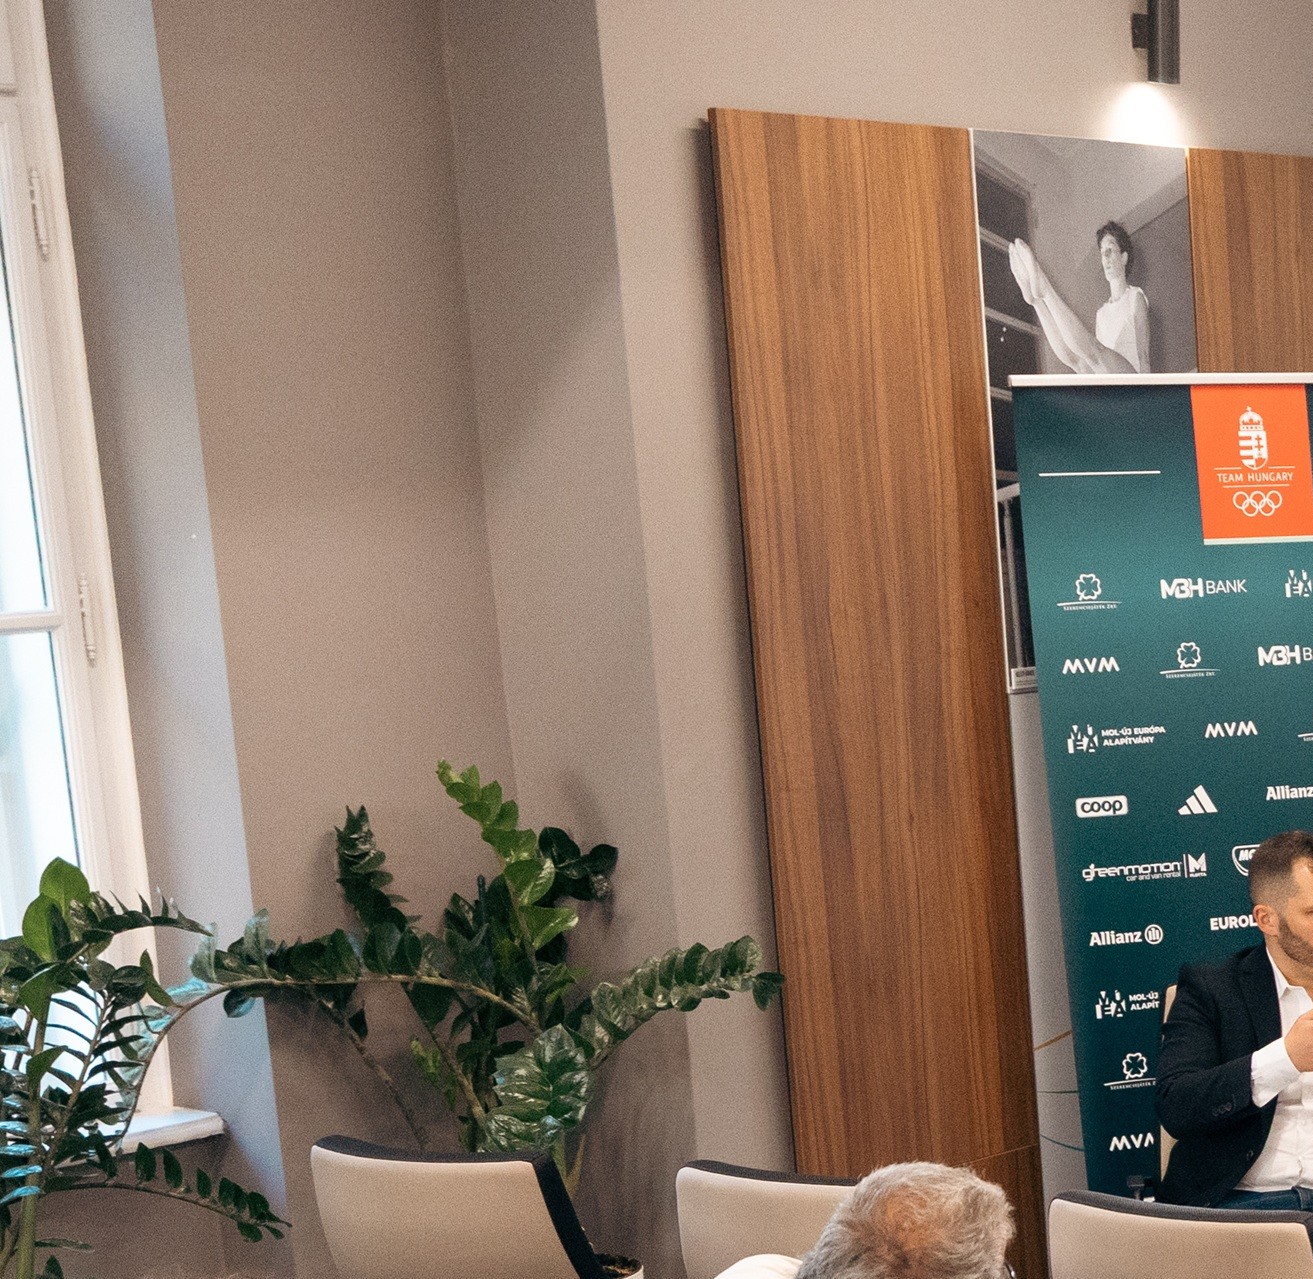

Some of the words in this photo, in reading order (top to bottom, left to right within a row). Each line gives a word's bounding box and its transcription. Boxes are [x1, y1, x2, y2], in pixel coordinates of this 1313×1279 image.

[1217, 473, 1243, 483] TEAM
[1248, 472, 1294, 482] HUNGARY
[1160, 577, 1204, 599] MBH
[1205, 579, 1247, 594] BANK
[1258, 644, 1301, 666] MBH
[1062, 656, 1120, 674] MVM
[1133, 724, 1166, 734] EURÓPA
[1204, 720, 1258, 738] MVM
[1080, 799, 1123, 815] coop
[1089, 931, 1142, 946] Allianz
